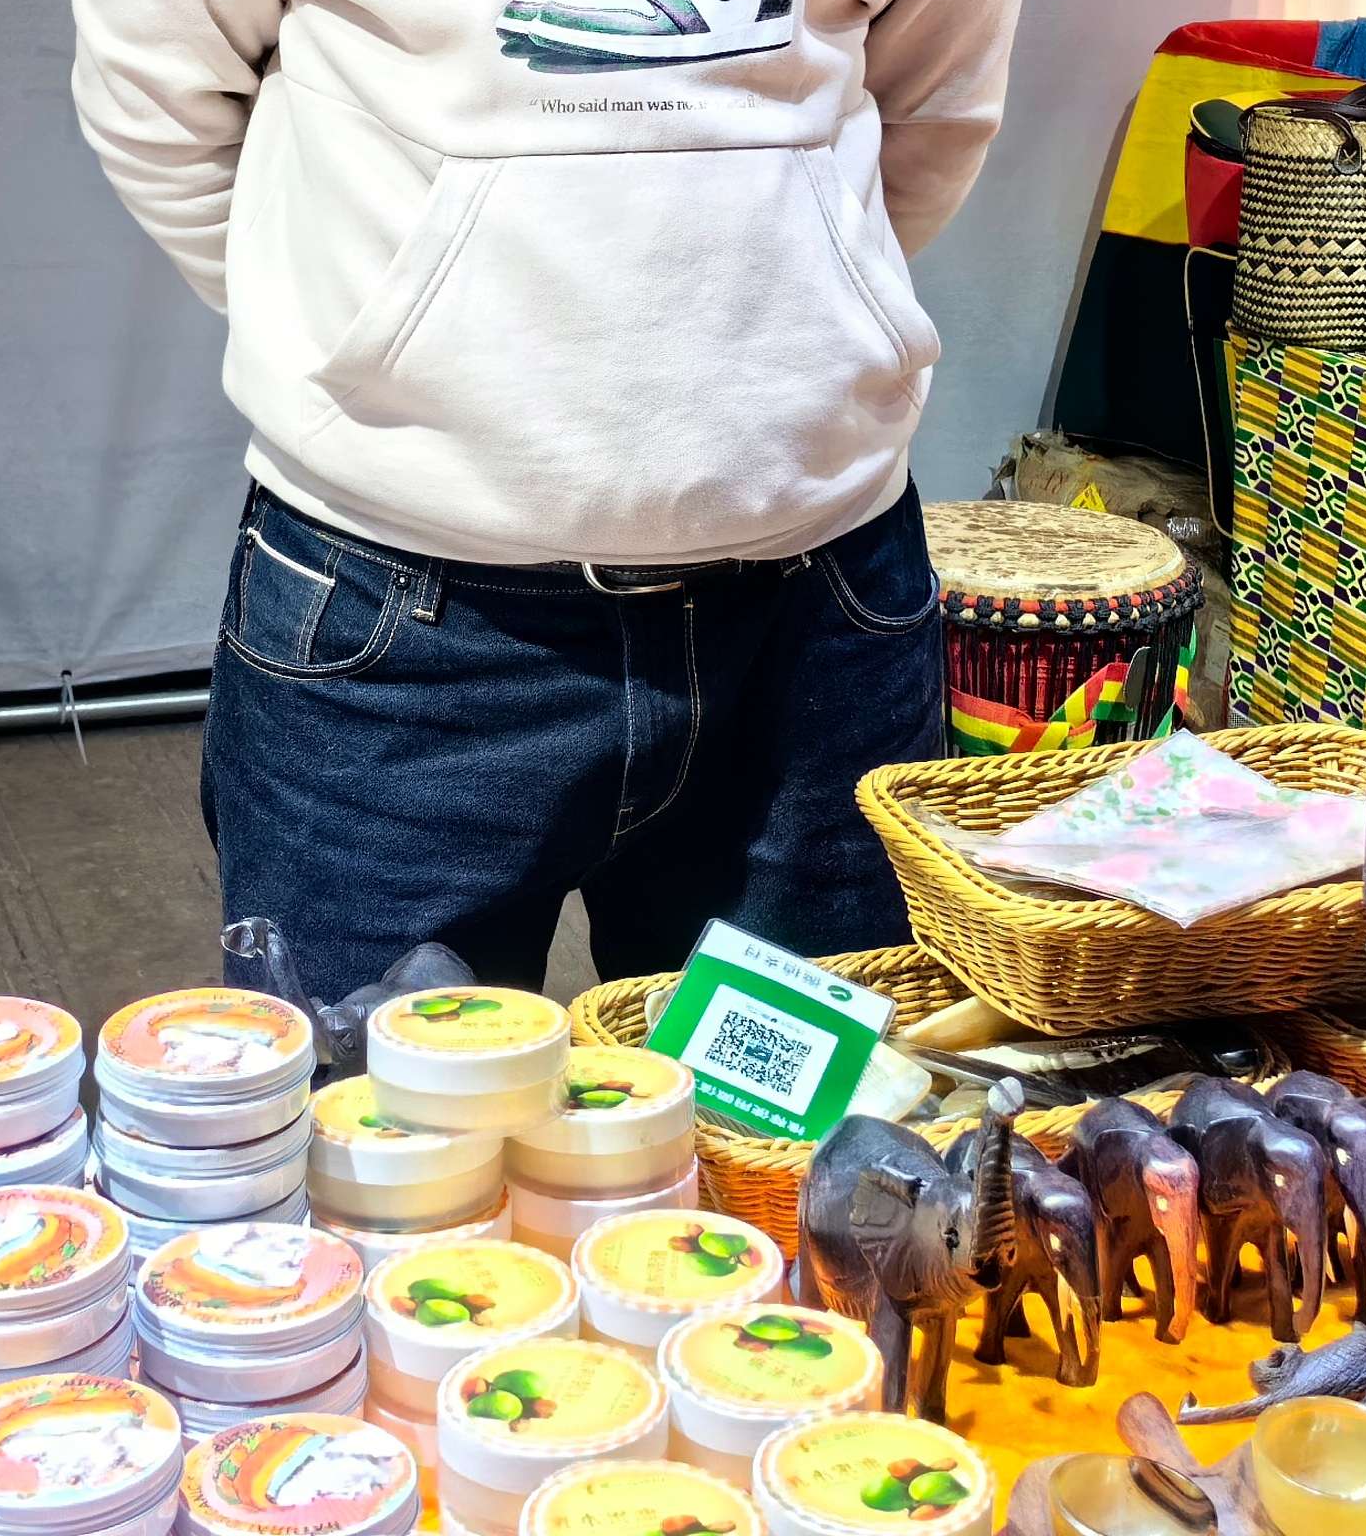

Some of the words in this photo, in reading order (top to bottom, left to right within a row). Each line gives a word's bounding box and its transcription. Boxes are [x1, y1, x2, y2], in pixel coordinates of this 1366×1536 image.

[578, 97, 608, 113] said
[611, 100, 643, 112] man
[647, 100, 674, 112] was
[695, 1077, 806, 1137] 推荐使用微信
